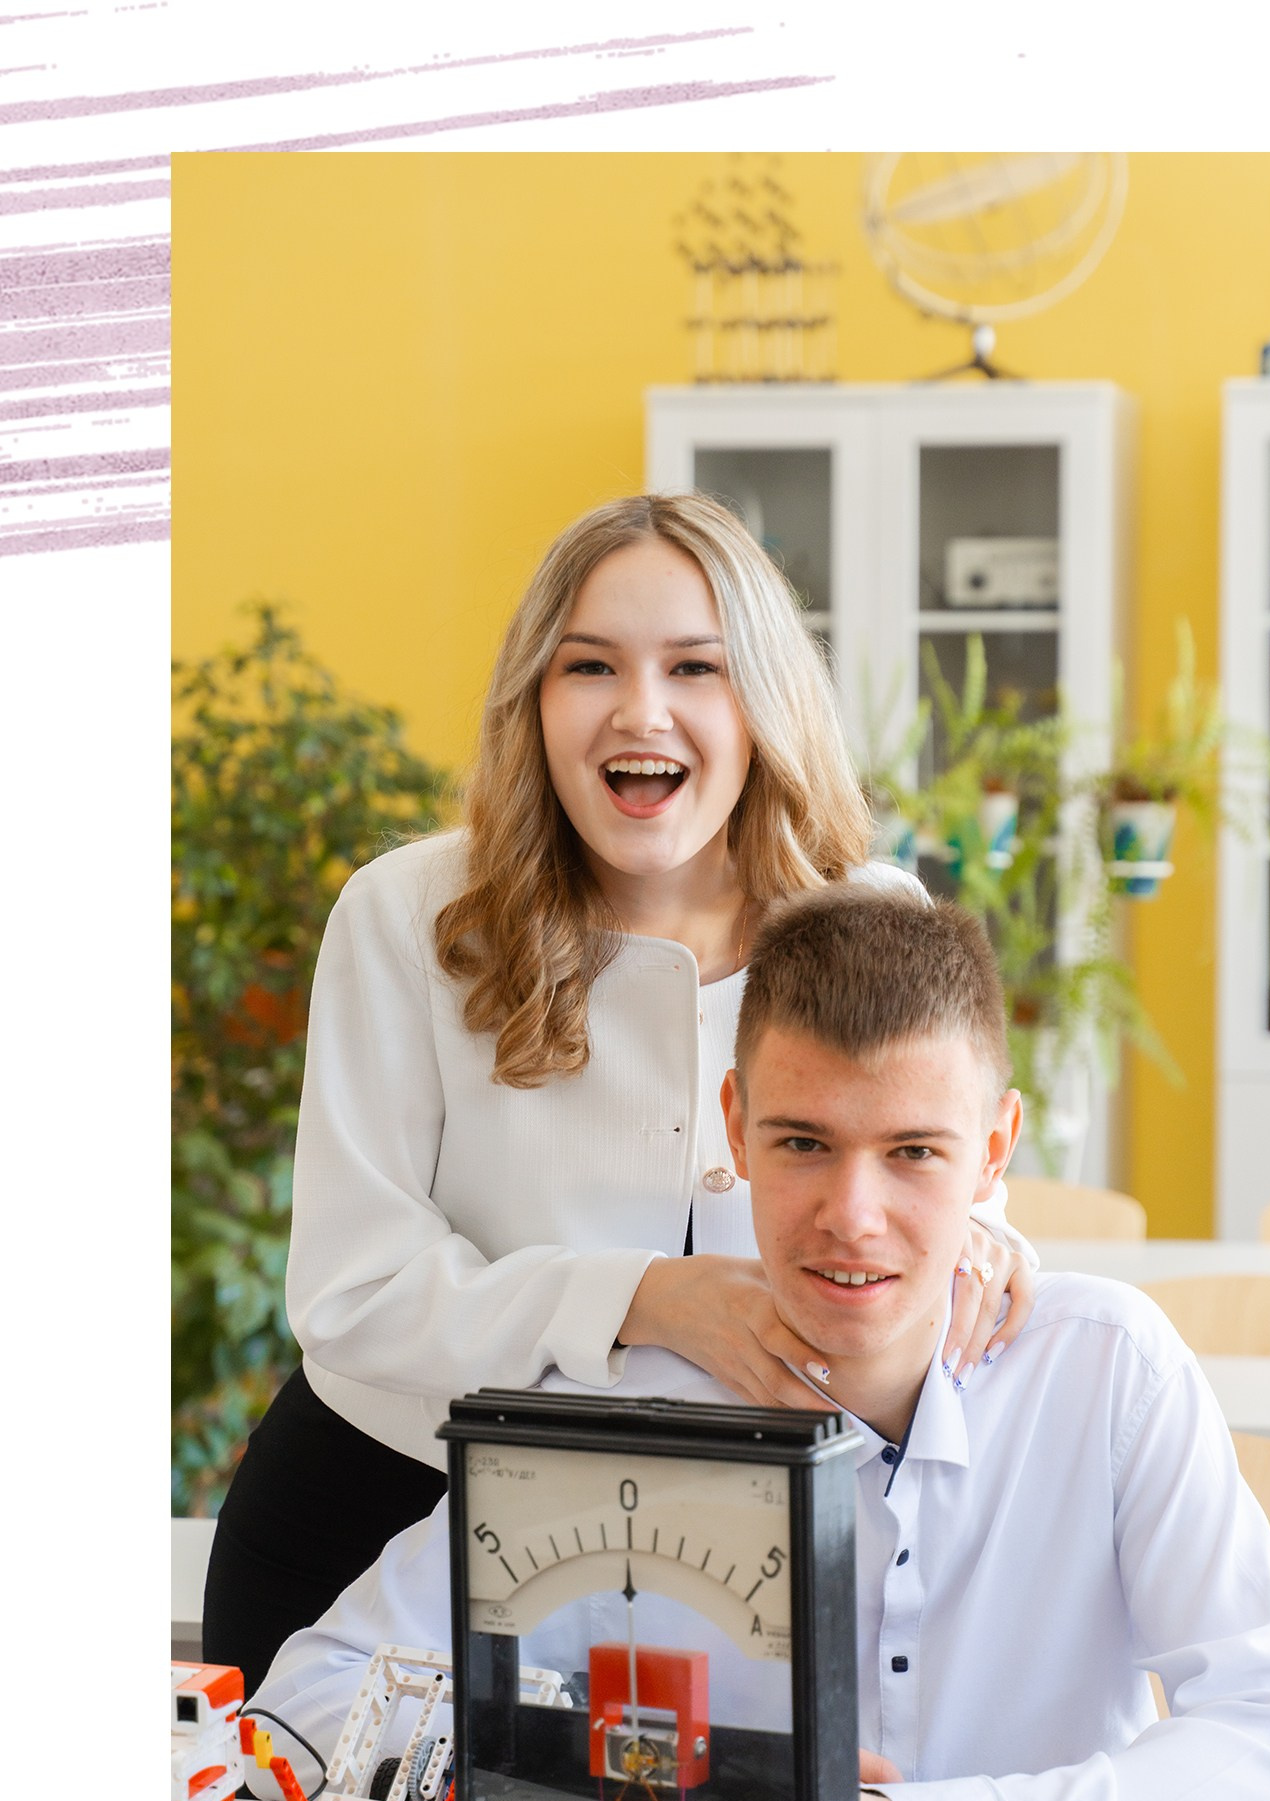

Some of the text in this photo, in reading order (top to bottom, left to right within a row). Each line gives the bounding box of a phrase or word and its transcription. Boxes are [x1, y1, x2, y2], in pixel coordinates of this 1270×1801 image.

[619, 1479, 638, 1511] 0
[473, 1523, 501, 1555] 5
[761, 1546, 788, 1579] 5
[751, 1614, 763, 1637] A
